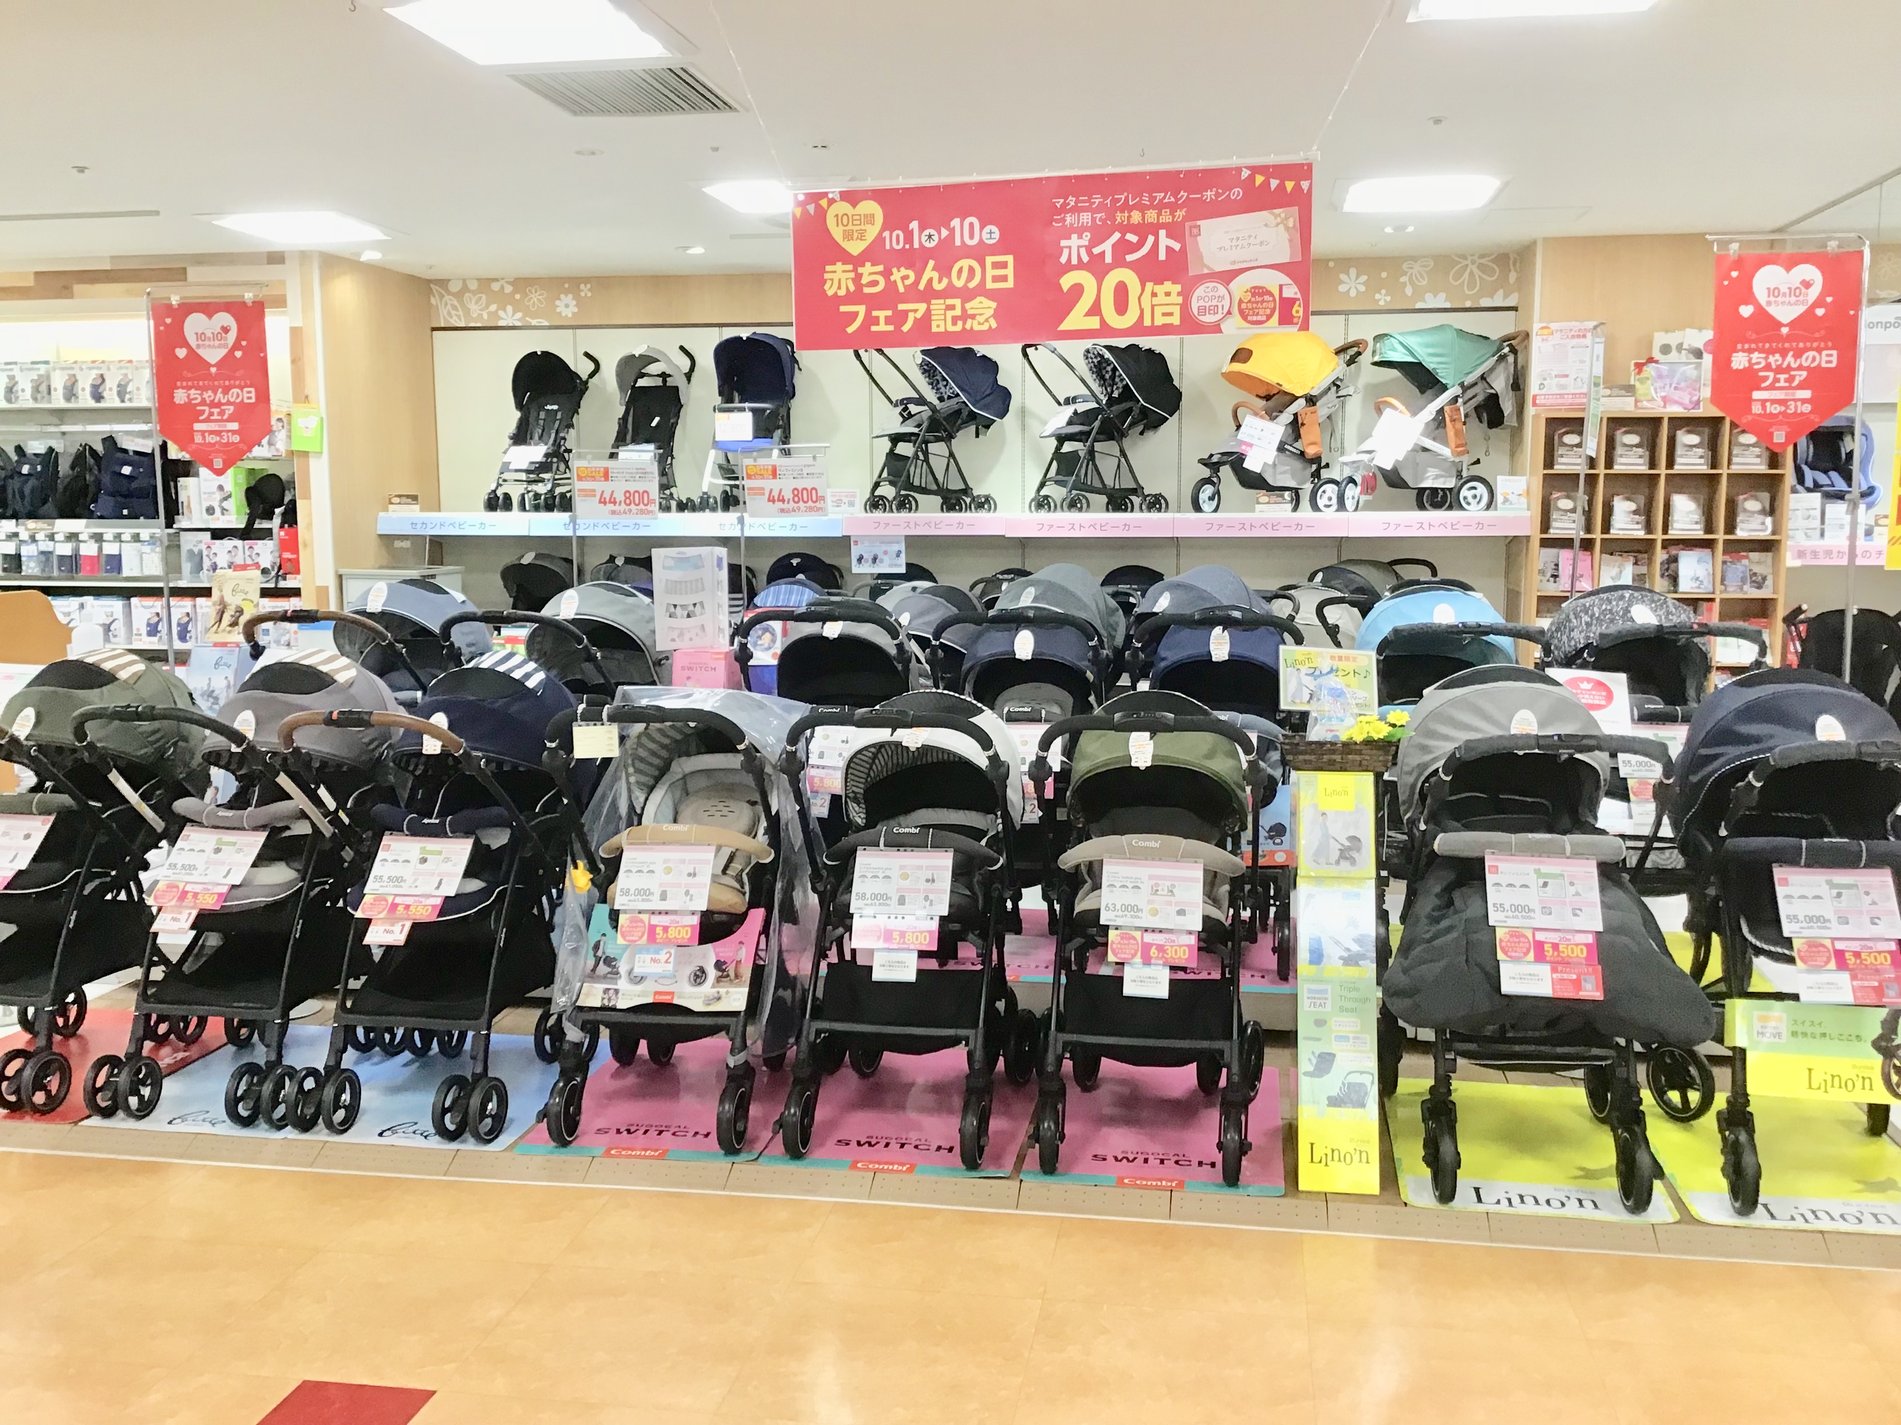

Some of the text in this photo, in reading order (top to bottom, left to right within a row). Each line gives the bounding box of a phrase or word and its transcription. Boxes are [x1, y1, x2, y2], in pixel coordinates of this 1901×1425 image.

[1052, 188, 1243, 209] マタニティプレミアムクーポンの
[833, 213, 875, 228] 10日間
[1052, 208, 1187, 228] ご利用で、対象商品が
[842, 229, 867, 242] 限定
[1059, 229, 1182, 265] ポイント
[823, 255, 1015, 297] 赤ちゃんの日
[1203, 286, 1219, 294] この
[1056, 267, 1183, 331] 20倍
[1196, 293, 1226, 304] POPが
[839, 296, 998, 335] フェア記念
[1731, 349, 1838, 370] 赤ちゃんの日
[1758, 370, 1808, 388] フェア
[173, 387, 256, 405] 赤ちゃんの日
[196, 405, 235, 420] フェア
[598, 489, 657, 508] 44,800円
[767, 487, 826, 505] 44,800円
[411, 520, 497, 530] セカンドベビーカー
[872, 520, 976, 530] ファーストベビーカー
[1036, 522, 1143, 532] ファーストベビーカー
[1204, 521, 1316, 532] ファーストベビーカー
[1381, 521, 1498, 531] ファーストベビーカー
[662, 824, 689, 832] Combi
[893, 826, 921, 834] Combi
[1132, 839, 1161, 849] Combi
[396, 904, 433, 916] 5,550
[655, 926, 692, 938] 5,800
[892, 931, 930, 945] 5,800
[1150, 945, 1189, 959] 6,300
[1544, 943, 1587, 958] 5,500
[1845, 951, 1892, 965] 5,500
[1791, 1019, 1825, 1028] スイスイ
[1756, 1030, 1783, 1040] MOVE
[1806, 1067, 1874, 1094] Lino'n
[593, 1126, 712, 1140] SWITCH
[610, 1148, 664, 1158] Combi
[834, 1138, 955, 1154] SWITCH
[1090, 1153, 1217, 1169] SWITCH
[1308, 1141, 1371, 1168] Lino'n
[856, 1161, 908, 1172] Combi
[1123, 1177, 1179, 1188] Combi
[1470, 1185, 1603, 1211] Lino'n
[1757, 1202, 1901, 1226] Lino'n
